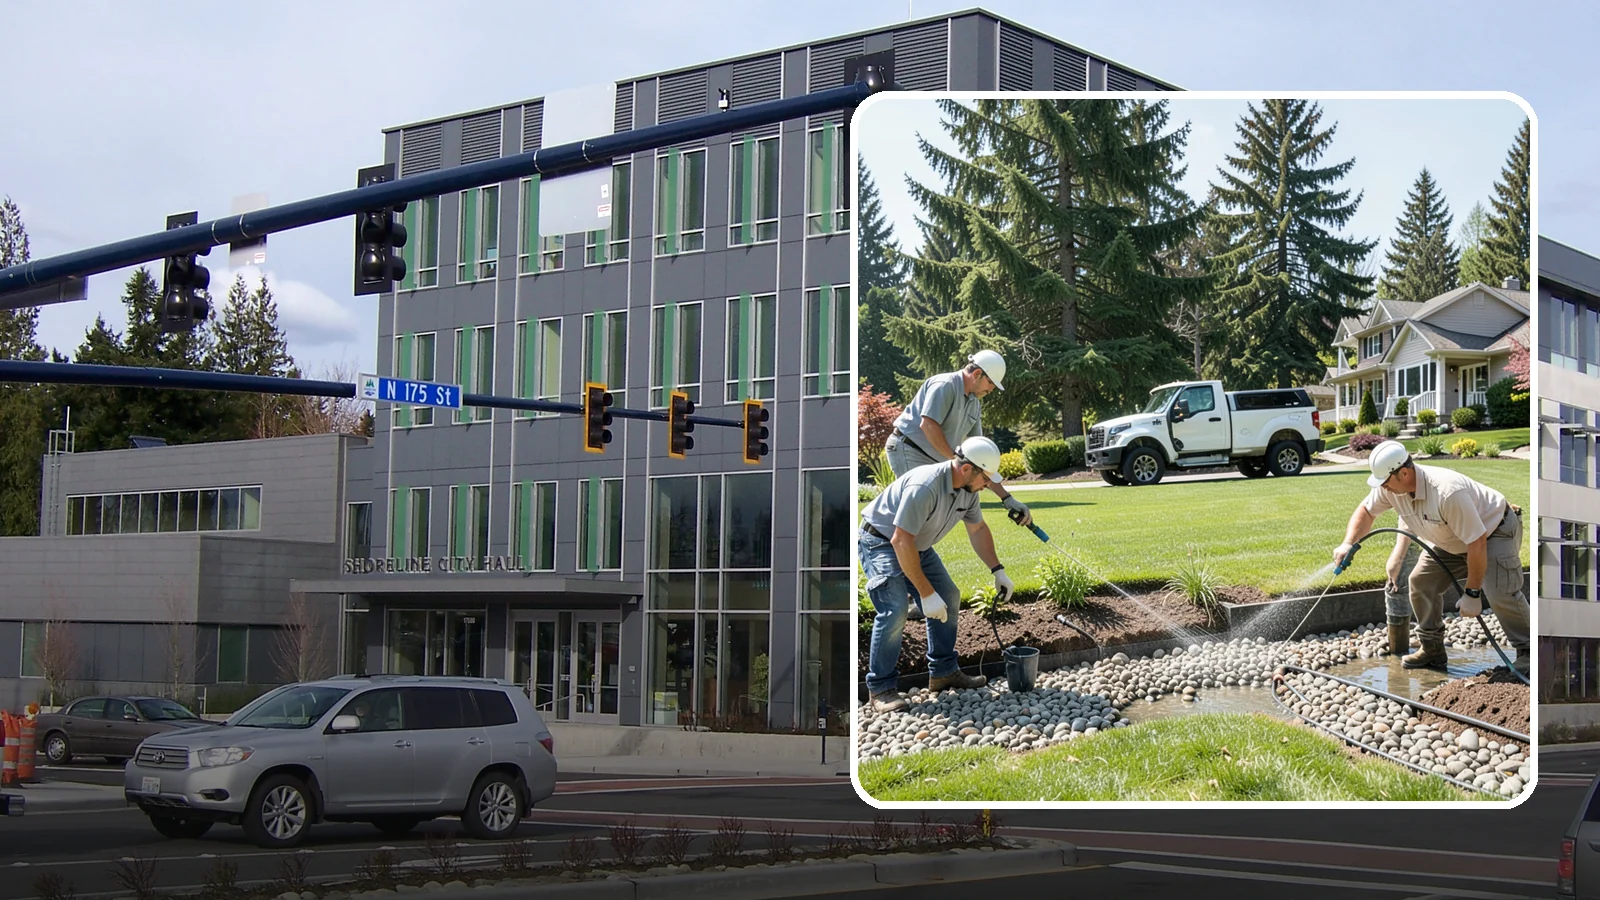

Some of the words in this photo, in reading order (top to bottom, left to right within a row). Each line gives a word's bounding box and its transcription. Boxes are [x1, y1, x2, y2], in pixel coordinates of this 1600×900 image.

[387, 380, 396, 400] N
[405, 382, 428, 403] 175
[436, 386, 451, 406] St
[344, 557, 432, 574] SHORELINE
[438, 556, 475, 572] CITY
[484, 555, 525, 571] HALL
